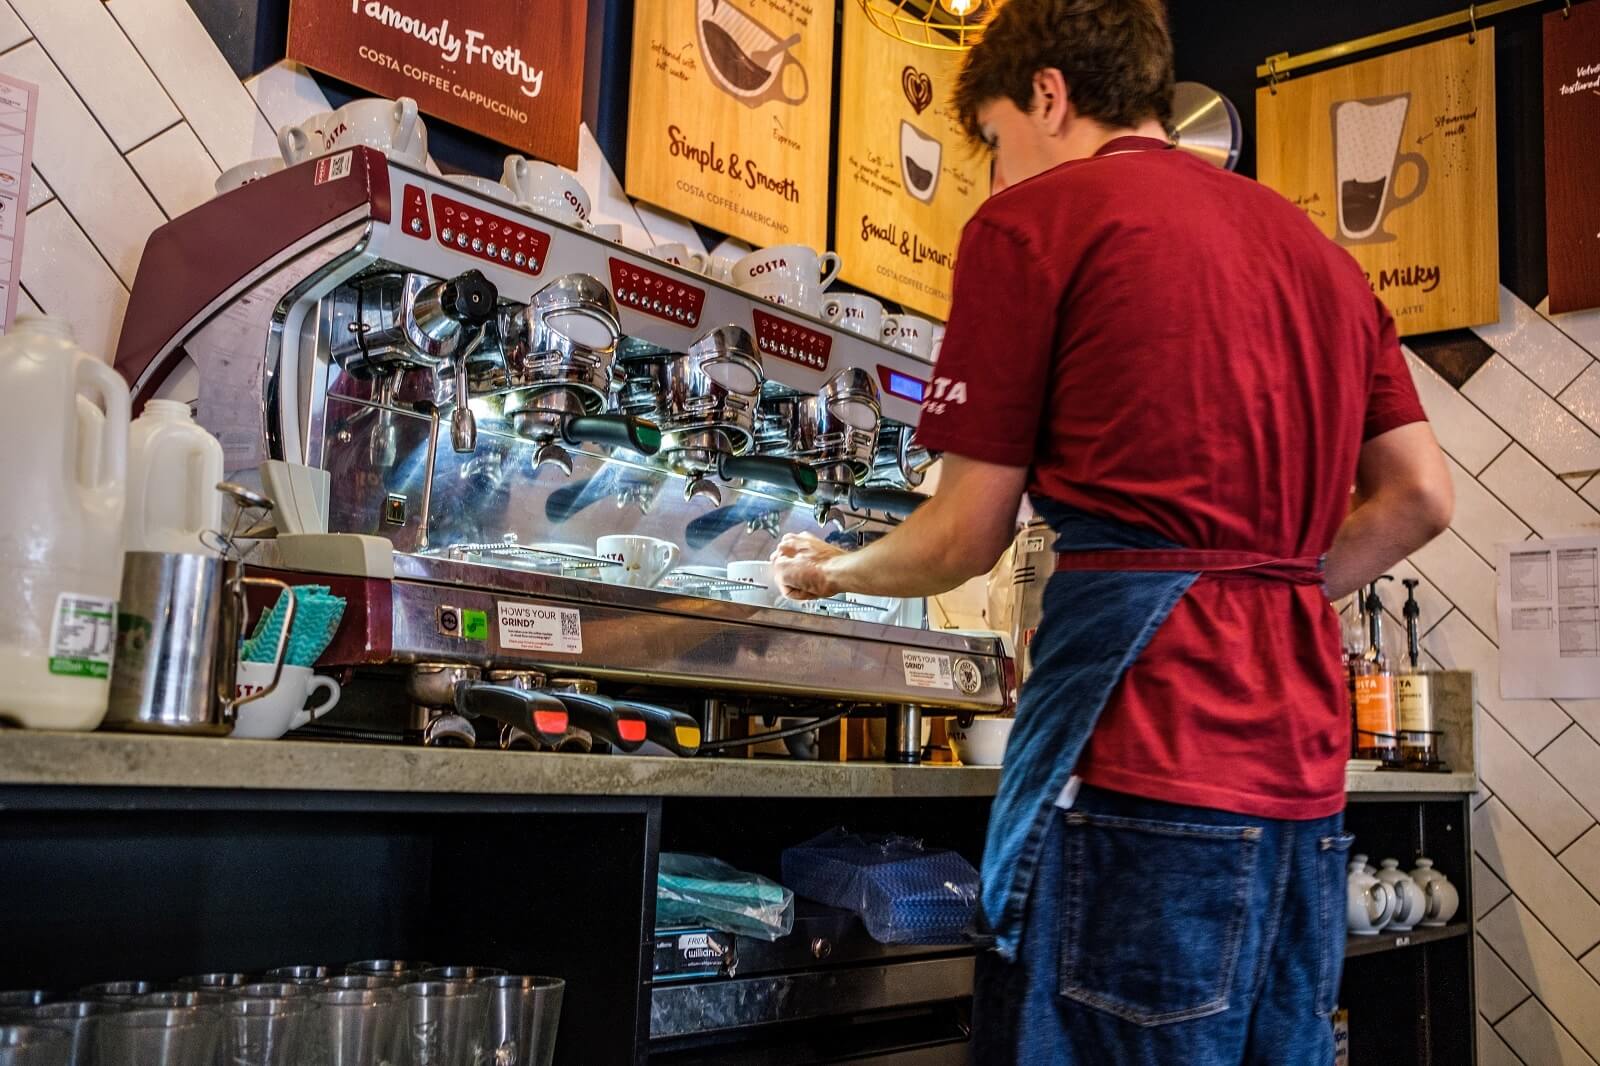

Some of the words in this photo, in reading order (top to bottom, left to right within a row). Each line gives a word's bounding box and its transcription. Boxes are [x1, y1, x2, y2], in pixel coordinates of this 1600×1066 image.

[465, 29, 544, 98] Frothy
[358, 45, 400, 73] COSTA
[402, 64, 451, 93] COFFEE
[452, 84, 528, 124] CAPPUCCINO
[668, 124, 725, 174] Simple
[728, 153, 742, 181] &
[745, 159, 800, 204] Smooth
[676, 179, 706, 199] COSTA
[706, 191, 739, 214] COFFEE
[740, 206, 790, 235] AMERICANO
[861, 214, 899, 247] Small
[899, 230, 911, 257] &
[912, 234, 956, 271] Luxuri
[749, 258, 788, 278] COSTA
[876, 263, 898, 282] COSTA
[898, 274, 924, 292] COFFEE
[1379, 264, 1440, 294] Milky
[1396, 304, 1425, 318] LATTE
[500, 606, 531, 618] HOW'S
[532, 609, 557, 620] YOUR
[501, 617, 535, 629] GRIND?
[905, 662, 924, 670] GRIND?
[922, 656, 937, 665] YOUR
